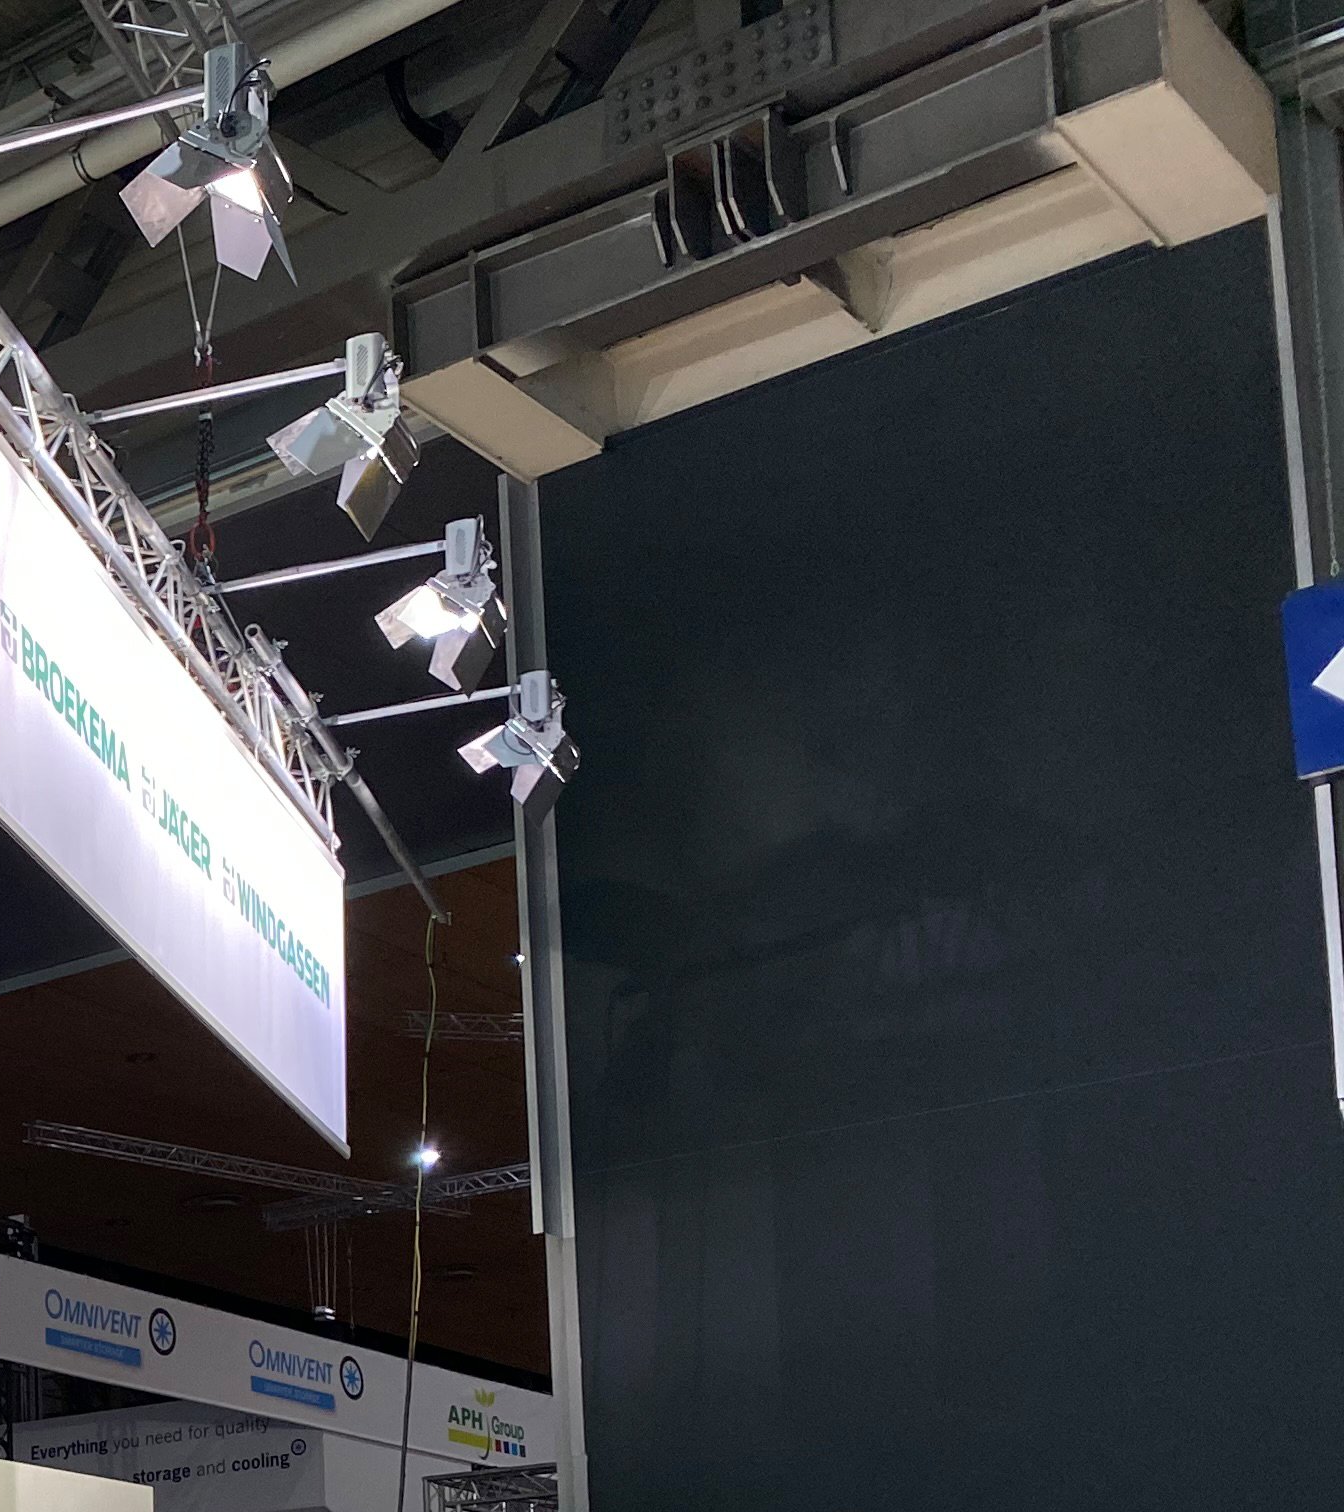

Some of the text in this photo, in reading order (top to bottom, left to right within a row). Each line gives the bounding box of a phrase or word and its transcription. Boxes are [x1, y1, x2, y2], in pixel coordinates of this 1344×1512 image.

[21, 624, 132, 793] BROEKEMA
[159, 789, 213, 880] JÄGER
[237, 872, 330, 1010] WINDGASSEN
[45, 1289, 143, 1339] OMNIVENT
[249, 1339, 334, 1385] OMNIVENT
[31, 1416, 270, 1460] Everything you need for quality
[448, 1404, 526, 1443] APH Group
[133, 1452, 290, 1484] storage and cooling
